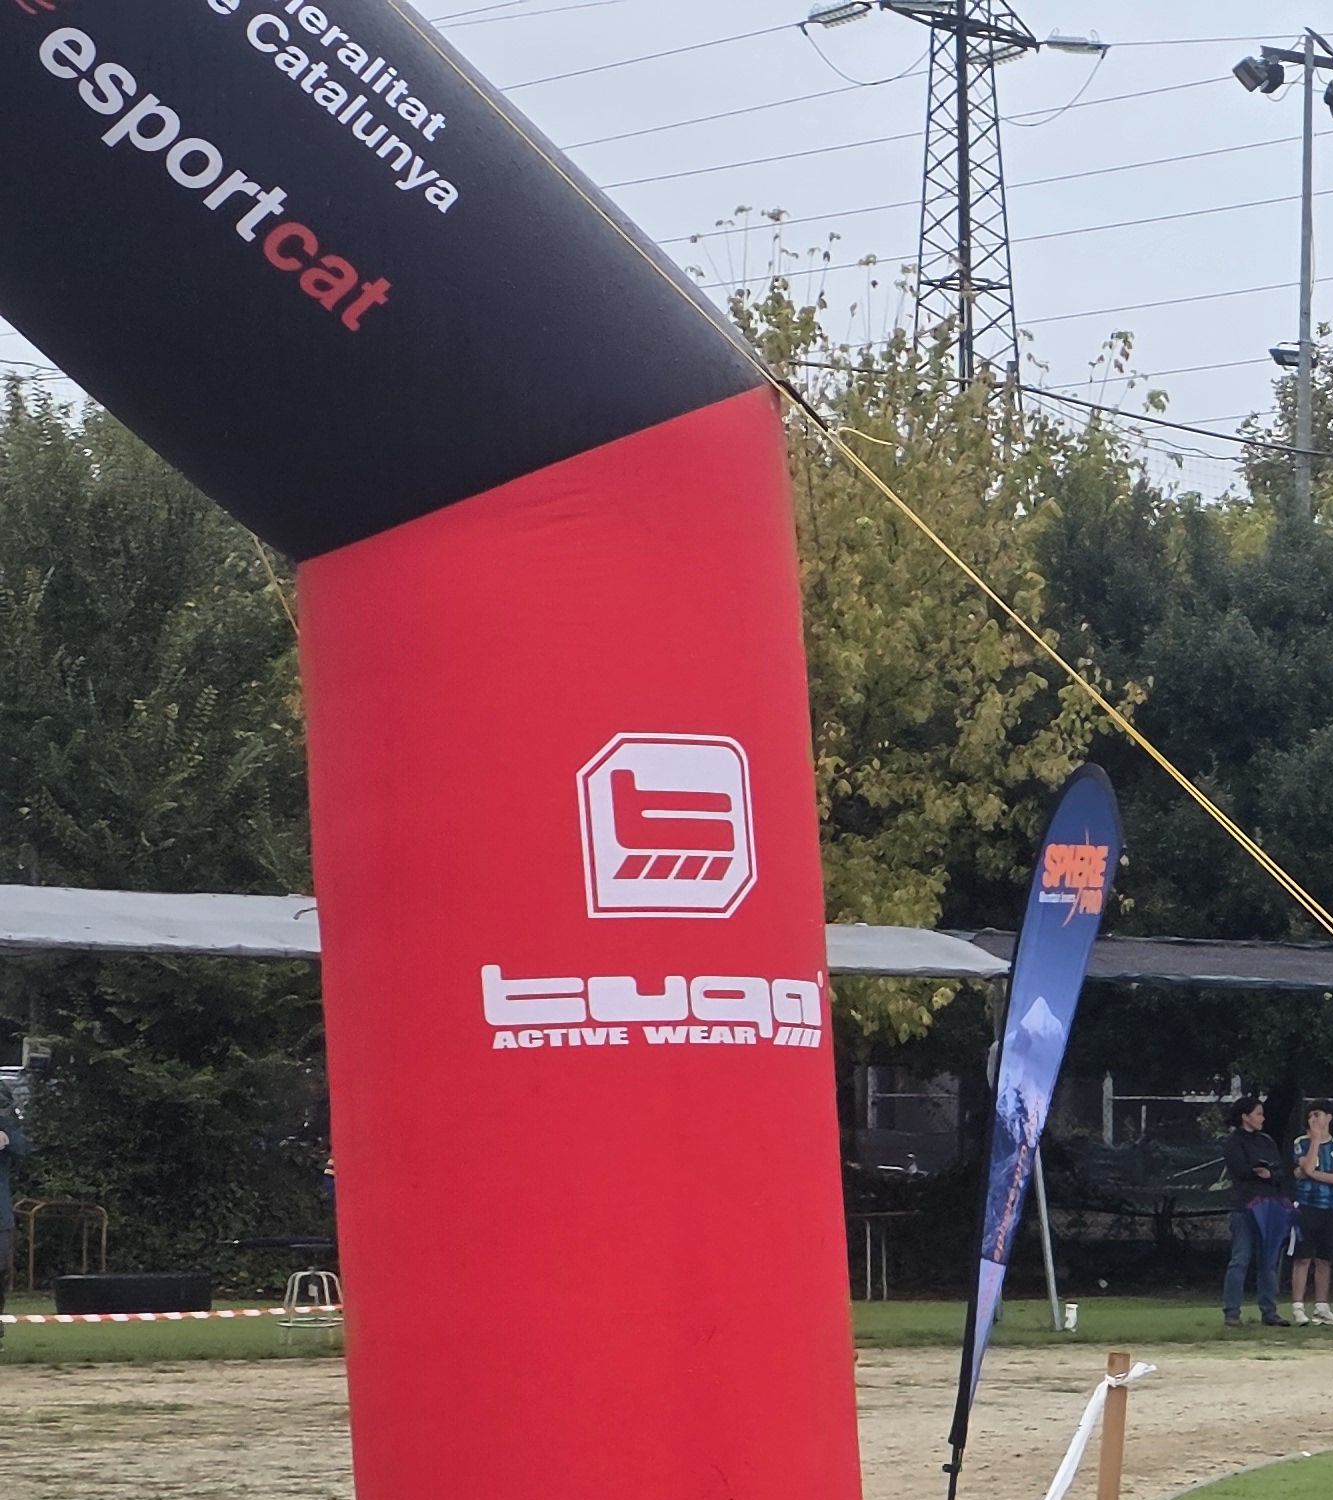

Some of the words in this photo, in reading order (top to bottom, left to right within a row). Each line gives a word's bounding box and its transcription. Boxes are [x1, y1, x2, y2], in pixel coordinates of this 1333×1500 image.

[39, 27, 392, 332] esportcat
[246, 13, 459, 214] Catalunya
[492, 1027, 630, 1050] ACTIVE
[643, 1025, 758, 1046] WEAR
